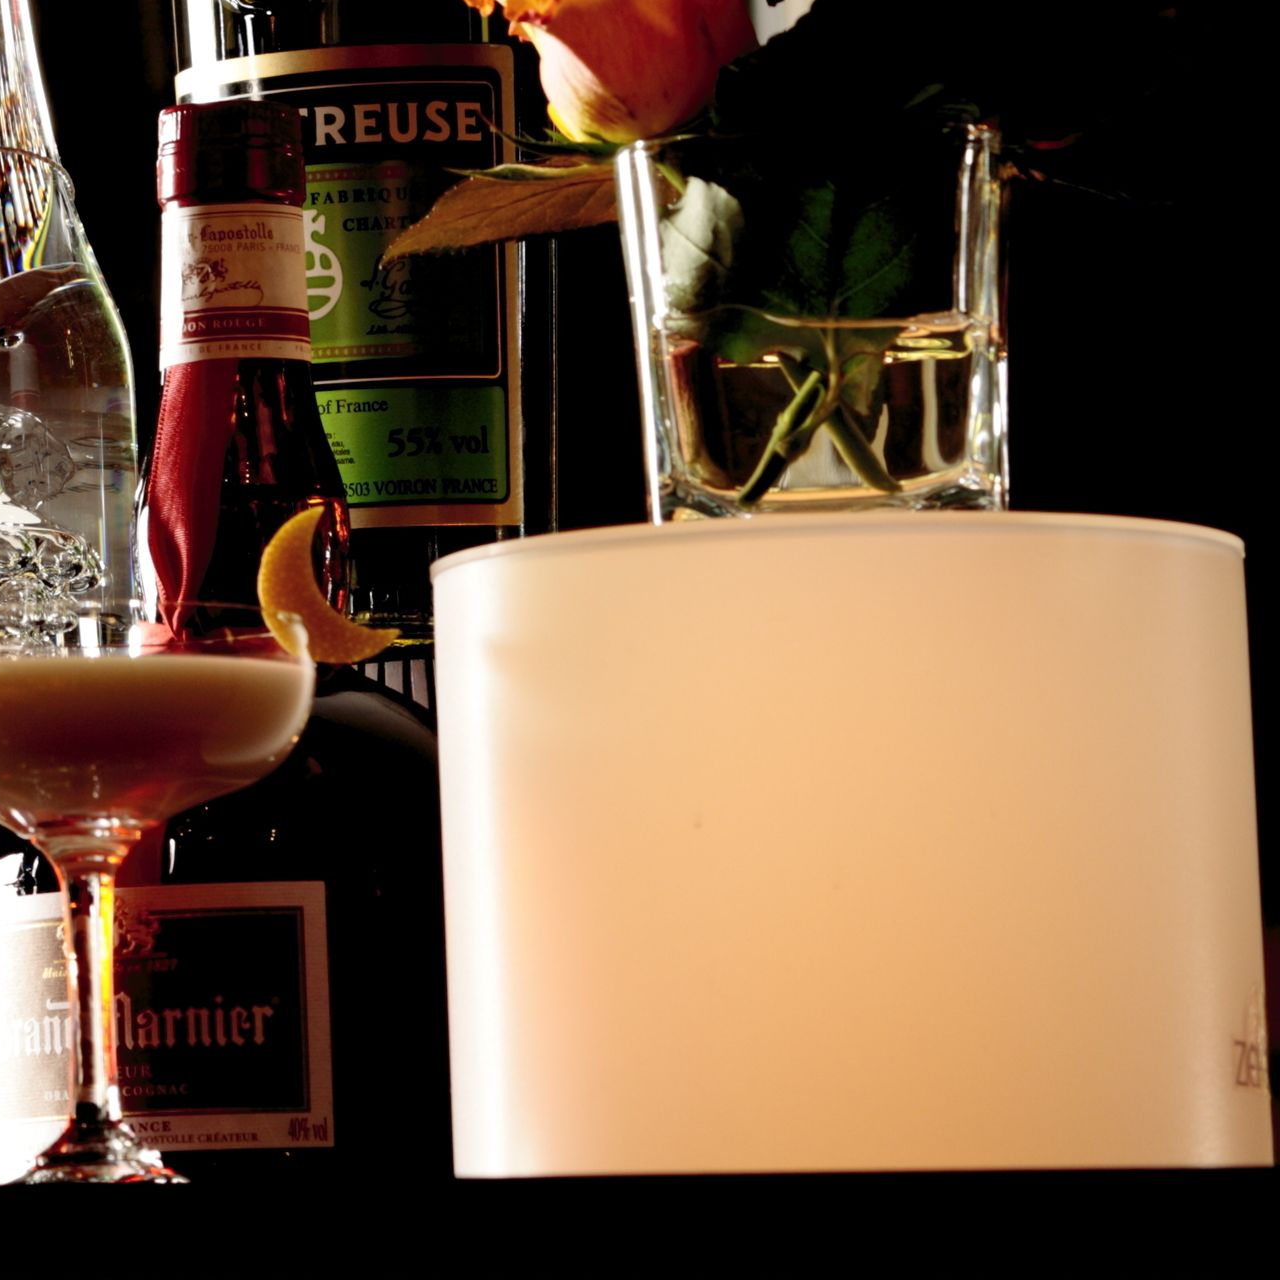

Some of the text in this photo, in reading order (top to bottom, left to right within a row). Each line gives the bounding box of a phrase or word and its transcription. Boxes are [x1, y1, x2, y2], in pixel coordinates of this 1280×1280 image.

[298, 101, 482, 146] REUSE
[237, 242, 266, 252] PARIS
[336, 399, 389, 414] France
[387, 425, 490, 458] 55% vol
[373, 478, 438, 496] VOIRON
[441, 477, 499, 494] FRANCE
